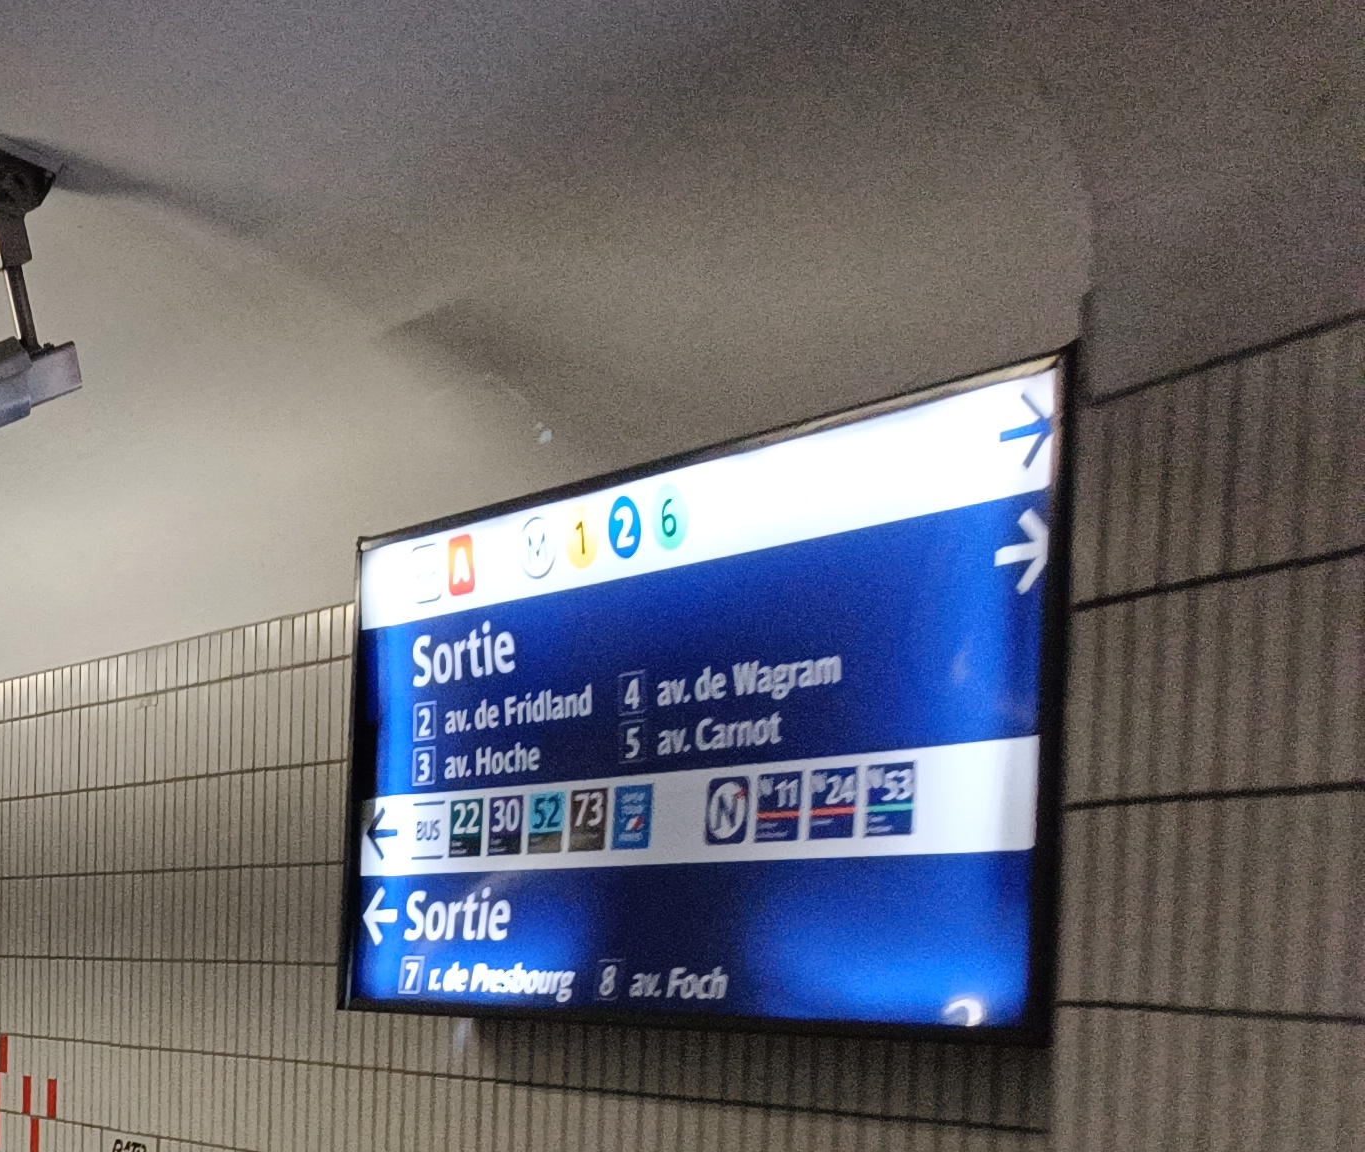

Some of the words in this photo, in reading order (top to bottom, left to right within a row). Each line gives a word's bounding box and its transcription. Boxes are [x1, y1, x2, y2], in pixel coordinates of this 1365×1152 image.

[575, 520, 587, 556] 1
[613, 505, 635, 549] 2
[662, 498, 678, 537] 6
[412, 619, 516, 688] Sortie
[624, 677, 640, 709] 4
[657, 678, 692, 707] av.
[694, 665, 727, 702] de
[732, 655, 842, 700] Wagram
[418, 707, 431, 738] 2
[444, 708, 472, 735] av.
[474, 698, 500, 730] de
[503, 682, 593, 727] Fridland
[625, 726, 640, 759] 5
[657, 727, 692, 756] av.
[695, 711, 783, 751] Carnot
[417, 752, 431, 782] 3
[443, 754, 472, 780] av.
[475, 741, 541, 776] Hoche
[416, 820, 440, 841] BUS
[452, 802, 480, 836] 22
[491, 798, 519, 832] 30
[532, 797, 562, 829] 52
[574, 791, 603, 827] 73
[403, 887, 512, 942] Sortie
[404, 961, 417, 990] 7
[427, 968, 441, 992] r.
[442, 961, 470, 992] de
[470, 961, 576, 1003] Presbourg
[599, 964, 617, 996] 8
[628, 972, 663, 998] av.
[665, 964, 729, 1000] Foch
